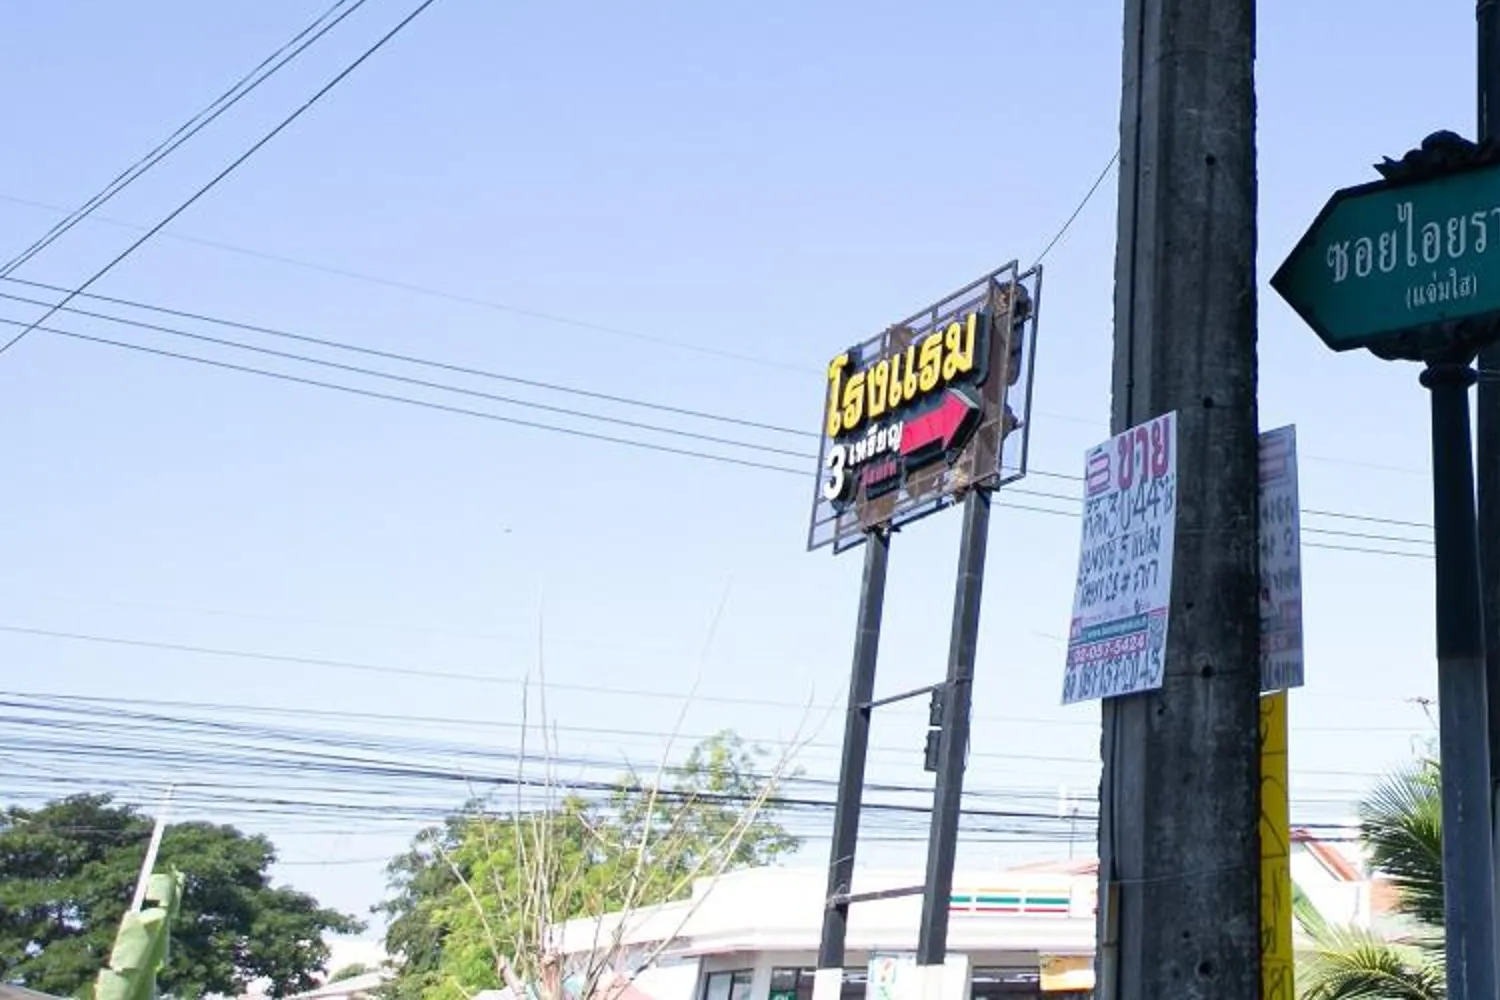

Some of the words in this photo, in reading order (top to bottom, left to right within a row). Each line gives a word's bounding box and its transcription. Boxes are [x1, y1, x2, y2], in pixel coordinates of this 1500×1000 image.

[826, 312, 977, 439] โรงแรม
[1118, 416, 1170, 490] ขาย
